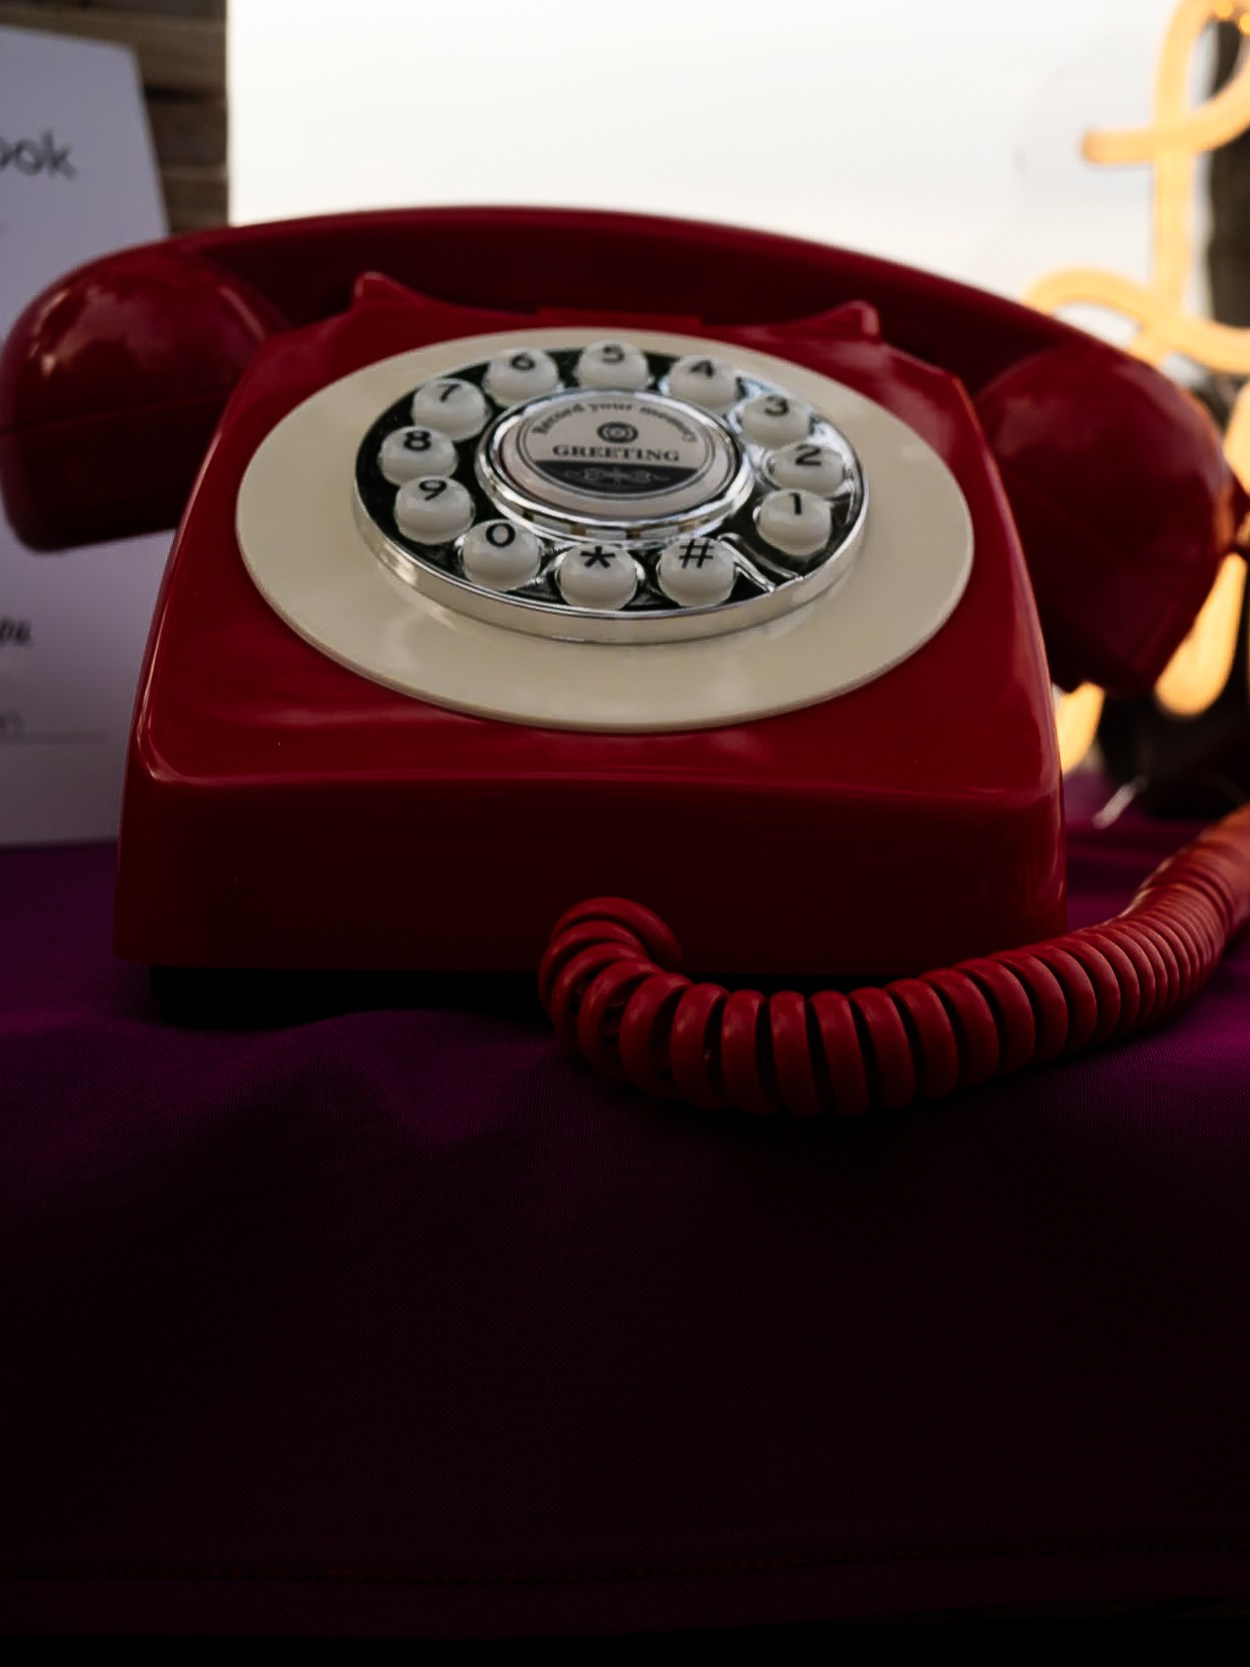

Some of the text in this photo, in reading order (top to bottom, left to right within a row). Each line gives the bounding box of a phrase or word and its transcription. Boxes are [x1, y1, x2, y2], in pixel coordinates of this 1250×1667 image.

[509, 351, 535, 372] 6
[602, 345, 625, 365] 5
[691, 359, 716, 379] 4
[437, 383, 463, 403] 7
[764, 396, 790, 417] 3
[531, 402, 584, 435] Record
[587, 401, 633, 413] your
[403, 429, 432, 453] 8
[551, 444, 681, 463] GREETING
[795, 444, 823, 467] 2
[418, 479, 448, 502] 9
[789, 494, 803, 516] 1
[485, 521, 516, 548] 0
